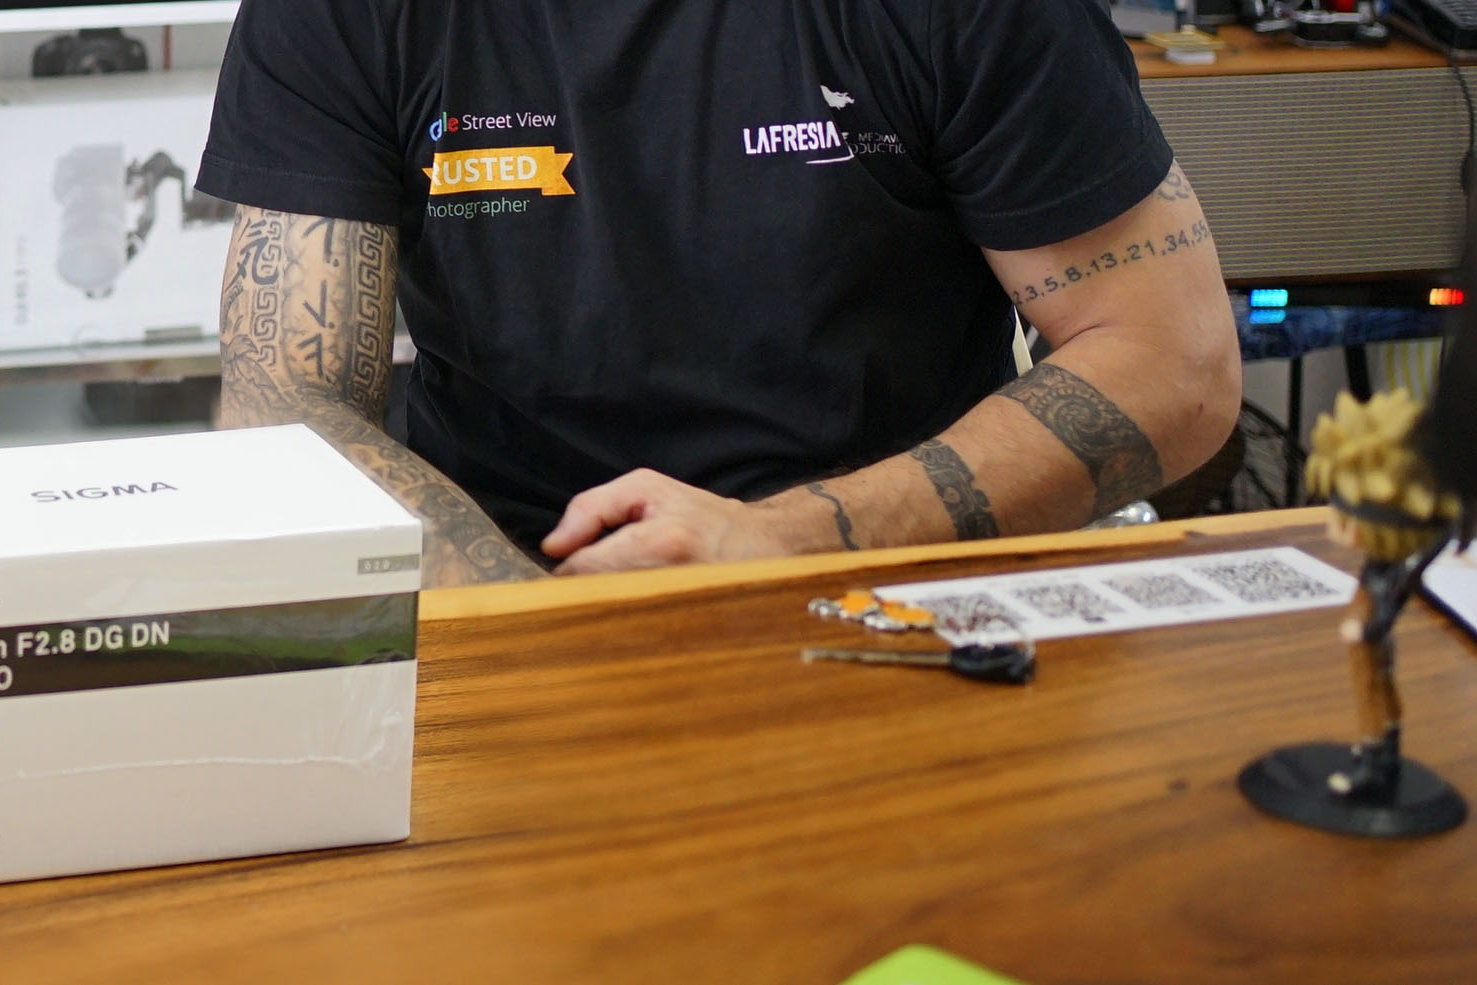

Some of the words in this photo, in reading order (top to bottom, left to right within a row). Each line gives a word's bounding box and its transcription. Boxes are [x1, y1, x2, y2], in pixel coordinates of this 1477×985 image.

[462, 114, 513, 130] Street
[516, 112, 557, 128] View
[743, 120, 841, 155] LAFRESIA
[428, 197, 531, 220] hotographer
[30, 481, 179, 503] SIGMA
[17, 629, 76, 657] F2.8
[84, 624, 124, 652] DG
[131, 621, 171, 648] DN
